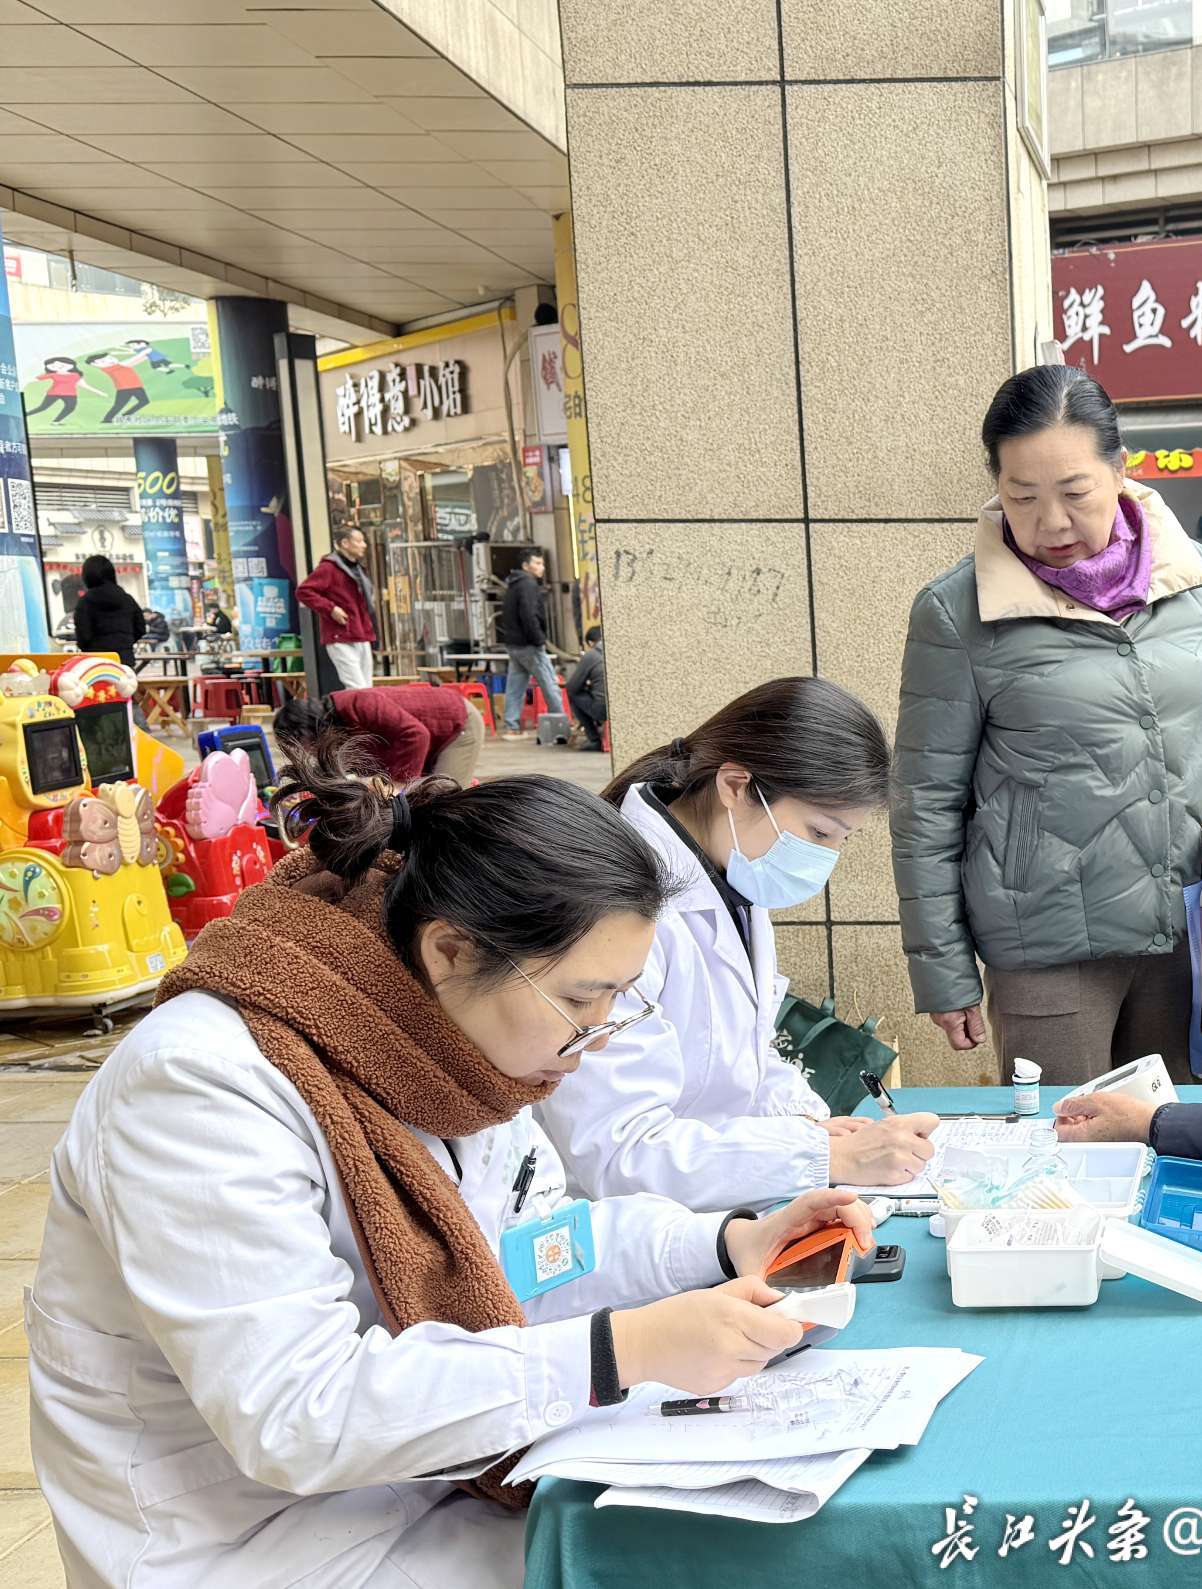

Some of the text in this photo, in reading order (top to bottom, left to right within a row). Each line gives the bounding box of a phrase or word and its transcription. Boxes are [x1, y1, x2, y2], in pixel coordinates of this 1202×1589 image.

[335, 359, 463, 442] 醉得意小馆
